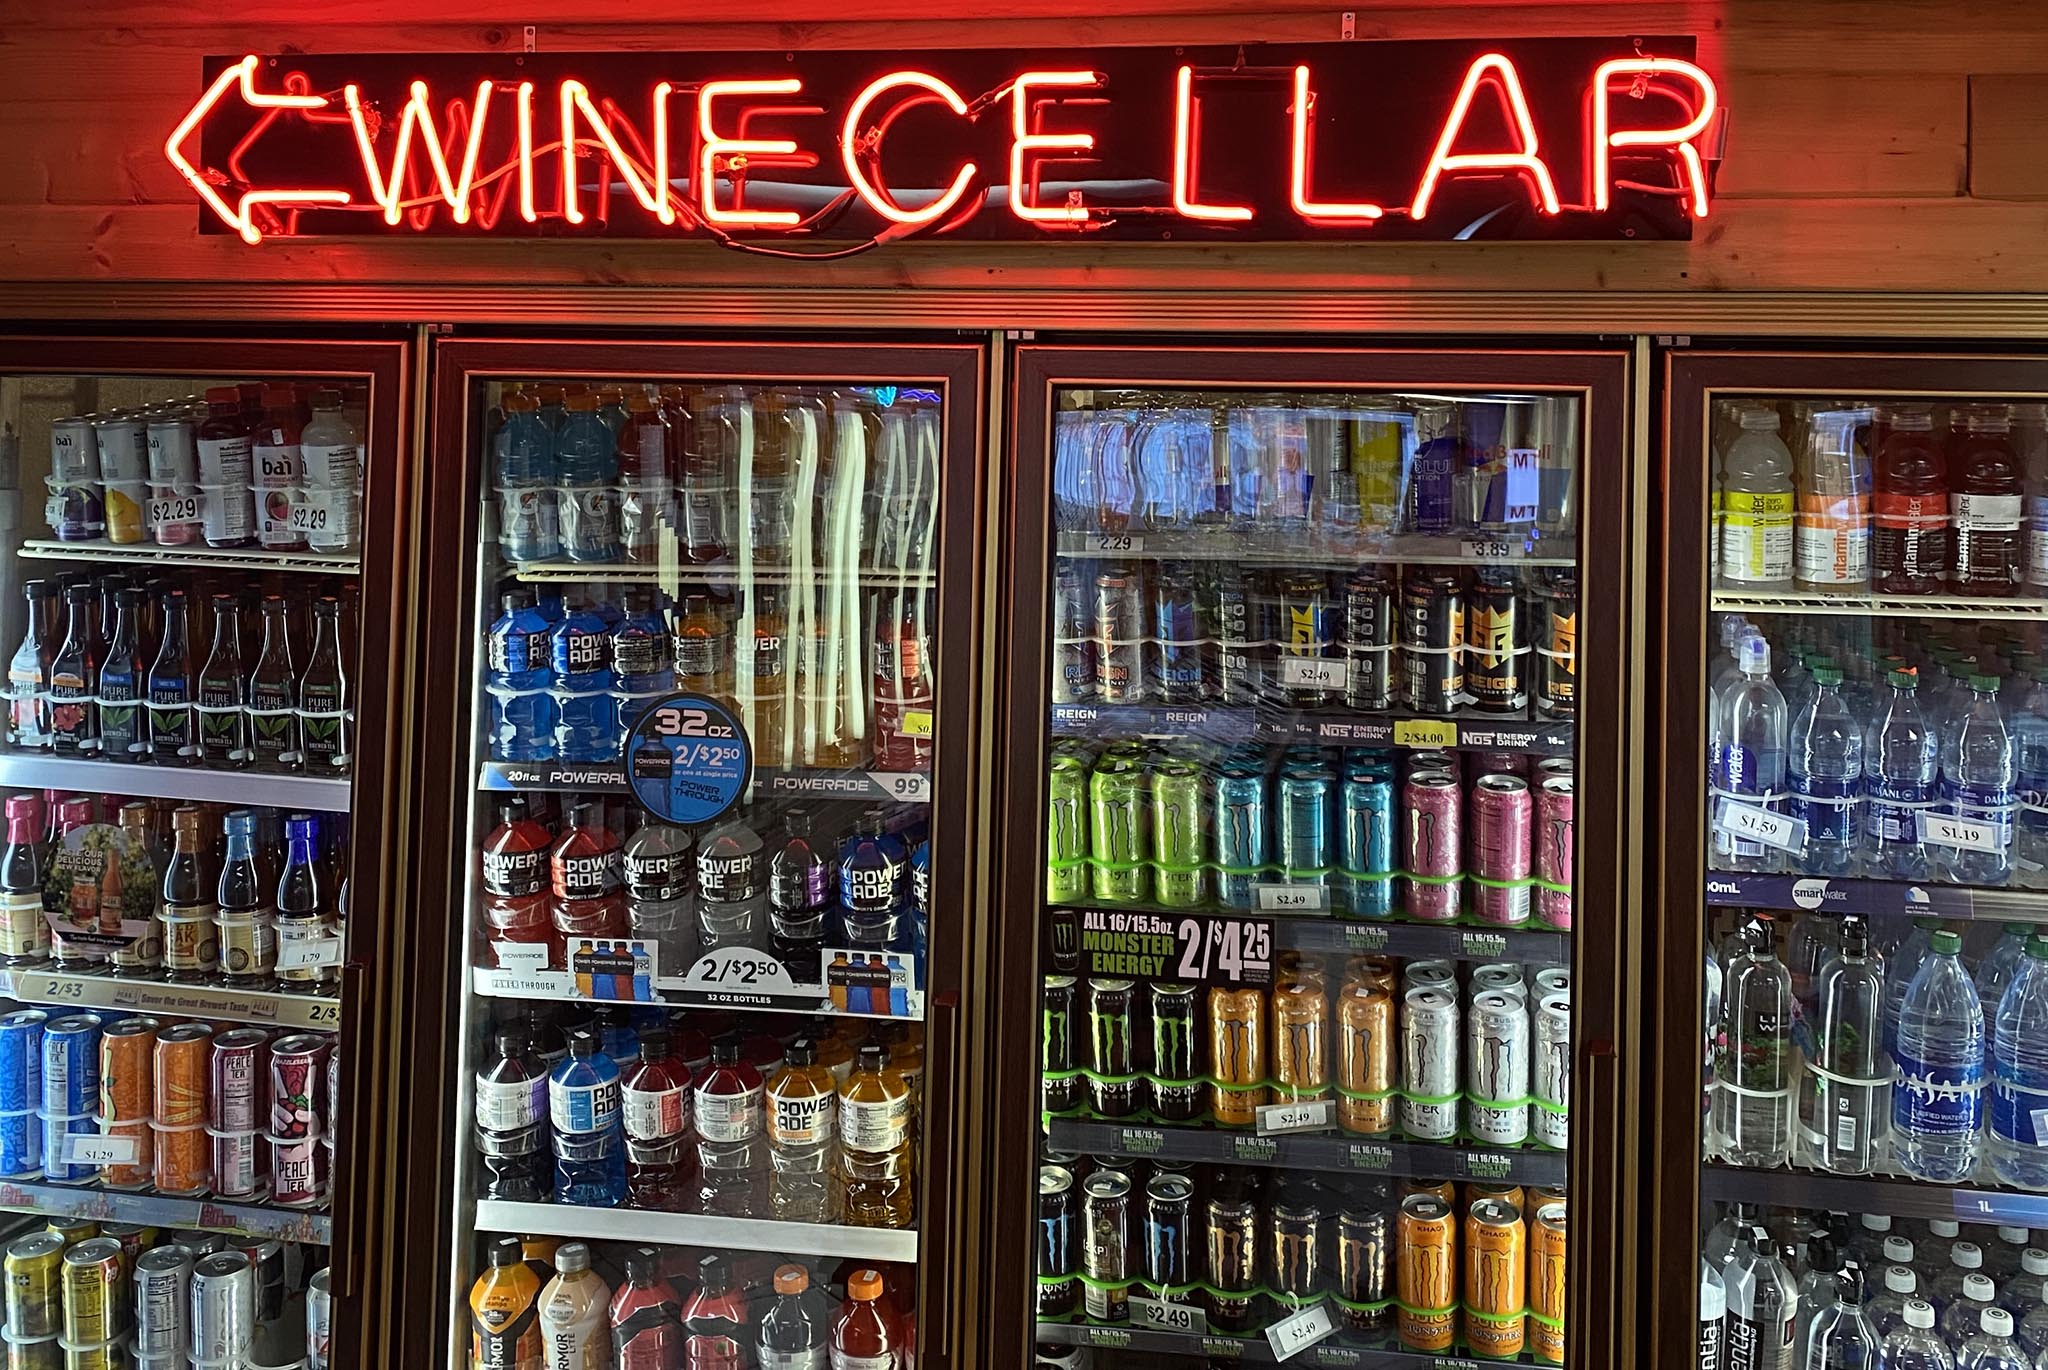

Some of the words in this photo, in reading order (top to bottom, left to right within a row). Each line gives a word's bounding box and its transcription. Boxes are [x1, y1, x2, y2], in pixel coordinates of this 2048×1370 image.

[343, 77, 803, 227] WINE
[842, 53, 1718, 224] CELLAR
[55, 434, 73, 447] bai
[261, 454, 292, 476] bai
[1413, 459, 1449, 475] BLU
[152, 498, 197, 522] $2.29
[293, 508, 327, 530] $2.29
[1471, 542, 1510, 557] $3.89
[569, 648, 602, 664] ADE
[1300, 669, 1330, 681] $2.49
[55, 685, 79, 696] PURE
[103, 685, 129, 696] PURE
[154, 690, 181, 701] PURE
[204, 693, 230, 703] PURE
[257, 695, 284, 706] PURE
[308, 697, 334, 707] PURE
[1056, 708, 1097, 720] REIGN
[1165, 712, 1207, 722] REIGN
[654, 708, 708, 737] 32
[916, 725, 931, 734] $0.
[1320, 724, 1353, 738] NOS
[1353, 725, 1393, 735] ENERGY
[1353, 731, 1384, 740] DRINK
[1403, 732, 1444, 744] 2/$4.00
[1462, 732, 1496, 745] NOS
[1496, 733, 1538, 742] ENERGY
[1496, 739, 1530, 748] DRINK
[550, 771, 627, 785] POWERA
[702, 770, 721, 778] single
[680, 780, 720, 795] POWER
[773, 777, 870, 792] POWERADE
[673, 787, 725, 805] THROUGH
[1740, 815, 1778, 835] $1.59
[1941, 826, 1980, 842] $1.19
[84, 849, 103, 858] OUR
[56, 855, 103, 866] DELICIOUS
[74, 865, 101, 873] FLAVOR
[566, 871, 603, 887] ADE
[852, 884, 889, 900] ADE
[1794, 888, 1848, 901] smartwater
[1276, 894, 1306, 905] $2.49
[1083, 912, 1107, 930] ALL
[1345, 925, 1357, 934] ALL
[1082, 930, 1175, 956] MONSTER
[1462, 932, 1474, 942] ALL
[301, 953, 320, 963] 1.79
[1092, 952, 1167, 977] ENERGY
[46, 981, 83, 997] 2/$3
[520, 981, 556, 991] THROUGH
[163, 996, 176, 1005] the
[177, 997, 199, 1008] Great
[199, 1000, 228, 1011] Brewed
[229, 1001, 249, 1012] Taste
[707, 993, 718, 1002] 32
[719, 994, 732, 1003] OZ
[733, 995, 772, 1005] BOTTLES
[226, 1056, 251, 1070] PEACE
[231, 1070, 245, 1079] TEA
[777, 1096, 835, 1116] POWER
[778, 1116, 812, 1130] ADE
[1280, 1113, 1310, 1123] $2.49
[1122, 1128, 1133, 1137] ALL
[1235, 1136, 1247, 1145] ALL
[1350, 1144, 1362, 1153] ALL
[85, 1151, 114, 1160] $1.29
[1467, 1153, 1479, 1163] ALL
[286, 1179, 304, 1192] TEA
[1977, 1200, 1994, 1213] 1L
[1479, 1229, 1511, 1238] KHAOS
[1544, 1233, 1566, 1243] KHA
[1147, 1305, 1190, 1328] $2.49
[1292, 1321, 1317, 1341] $2.49
[1728, 1319, 1750, 1370] entia
